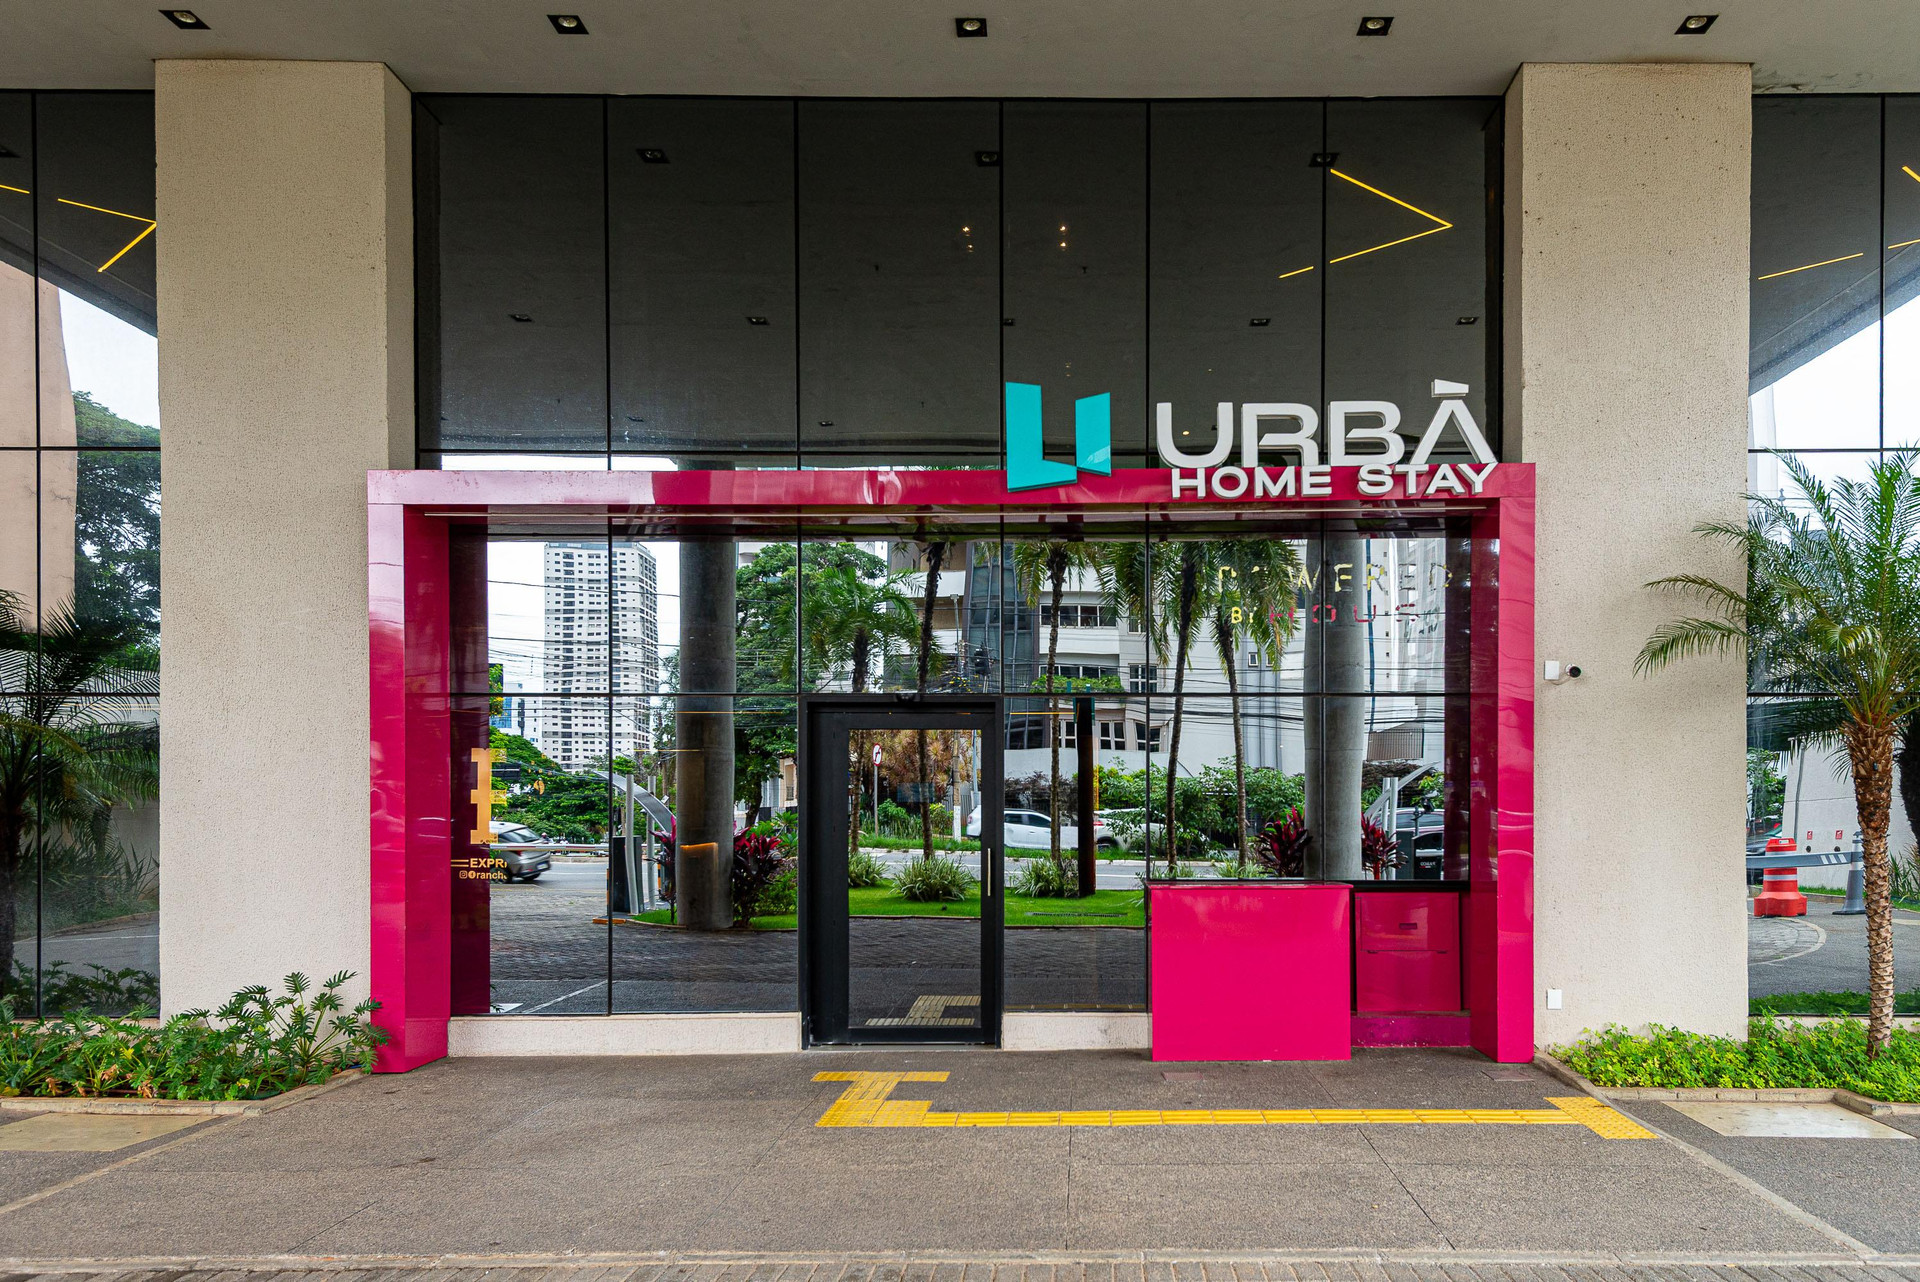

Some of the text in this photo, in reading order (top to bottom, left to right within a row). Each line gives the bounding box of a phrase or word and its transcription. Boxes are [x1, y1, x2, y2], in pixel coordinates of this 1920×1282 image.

[1171, 462, 1499, 499] HOME STAY
[1217, 563, 1453, 596] PWERED
[470, 858, 508, 868] EXPR
[476, 870, 508, 880] ranch
